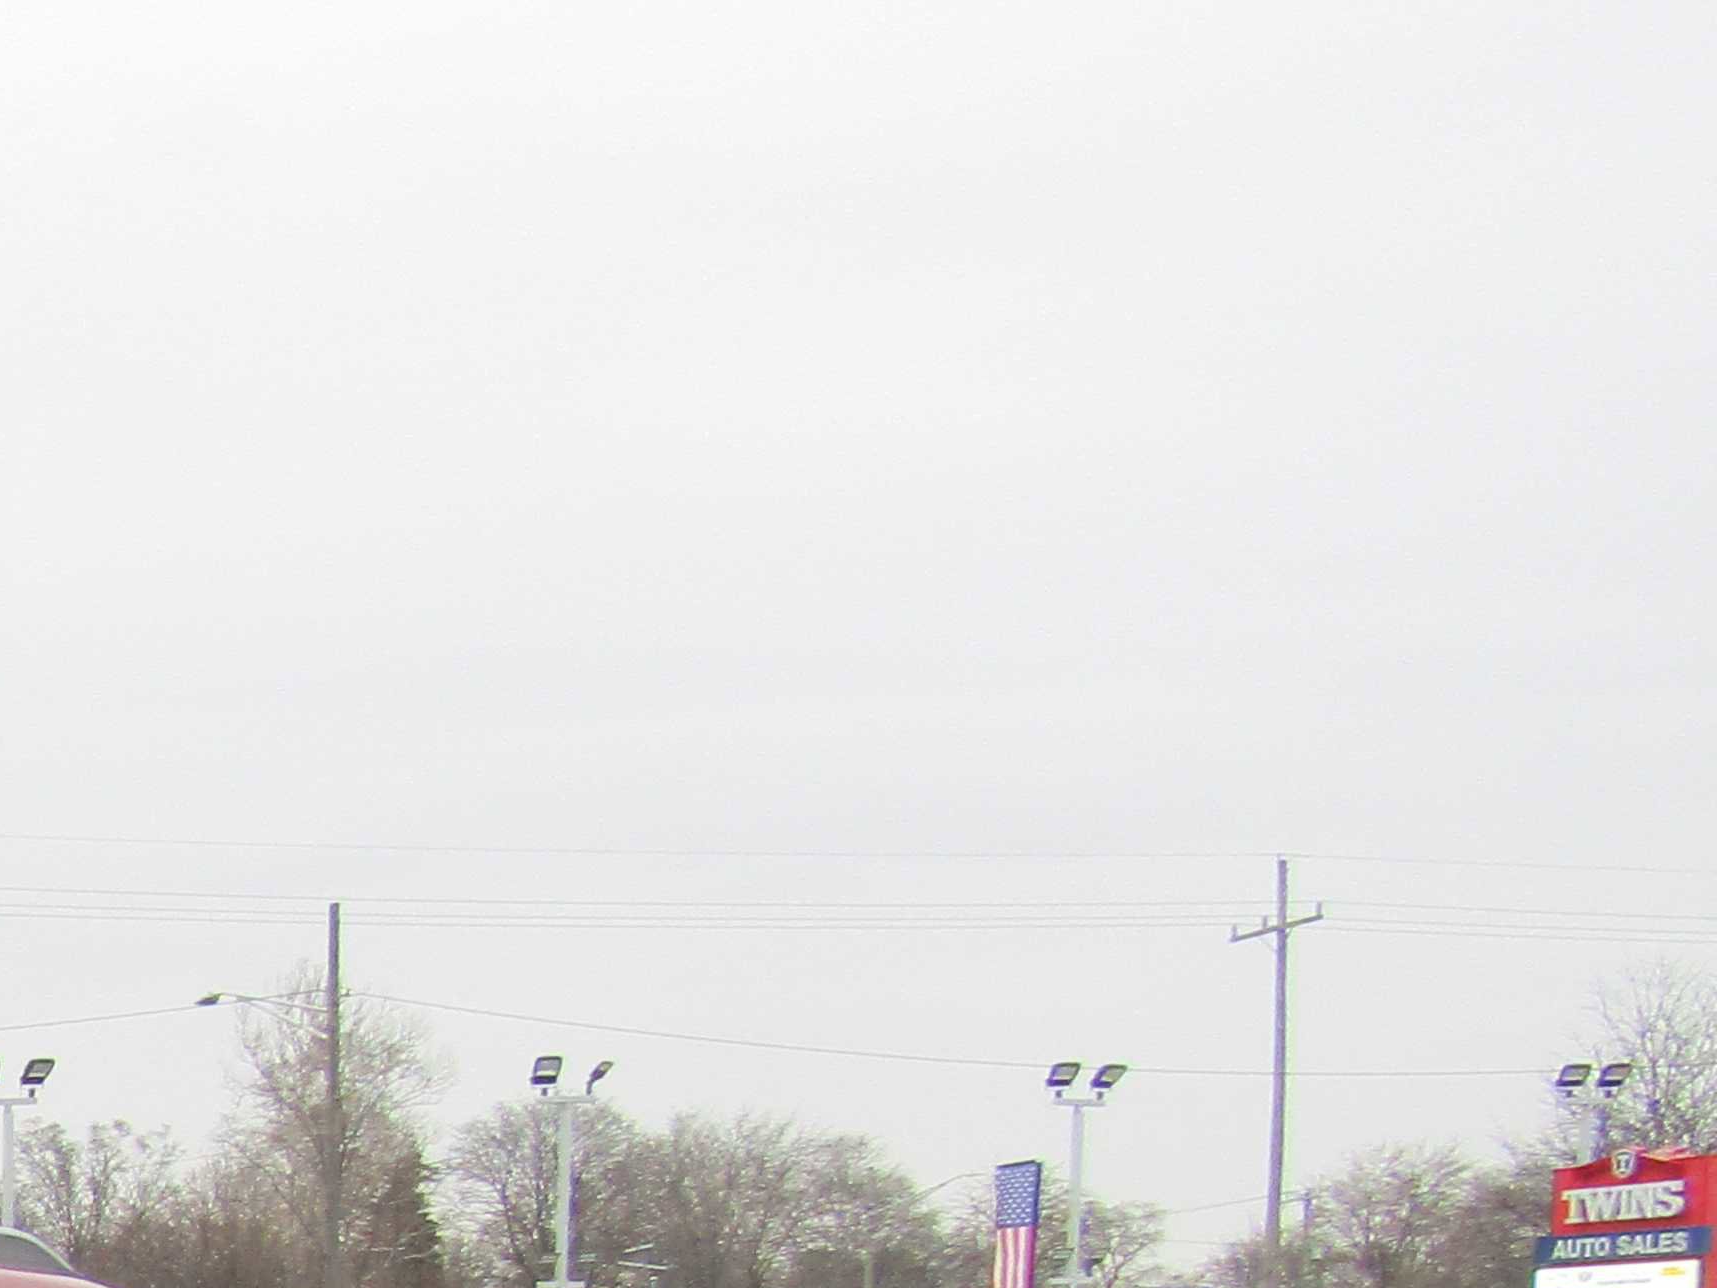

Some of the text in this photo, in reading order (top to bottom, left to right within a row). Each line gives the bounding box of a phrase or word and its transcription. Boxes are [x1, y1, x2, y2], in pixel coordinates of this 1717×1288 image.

[1562, 1180, 1686, 1225] TWINS
[1551, 1231, 1689, 1260] AUTO SALES
